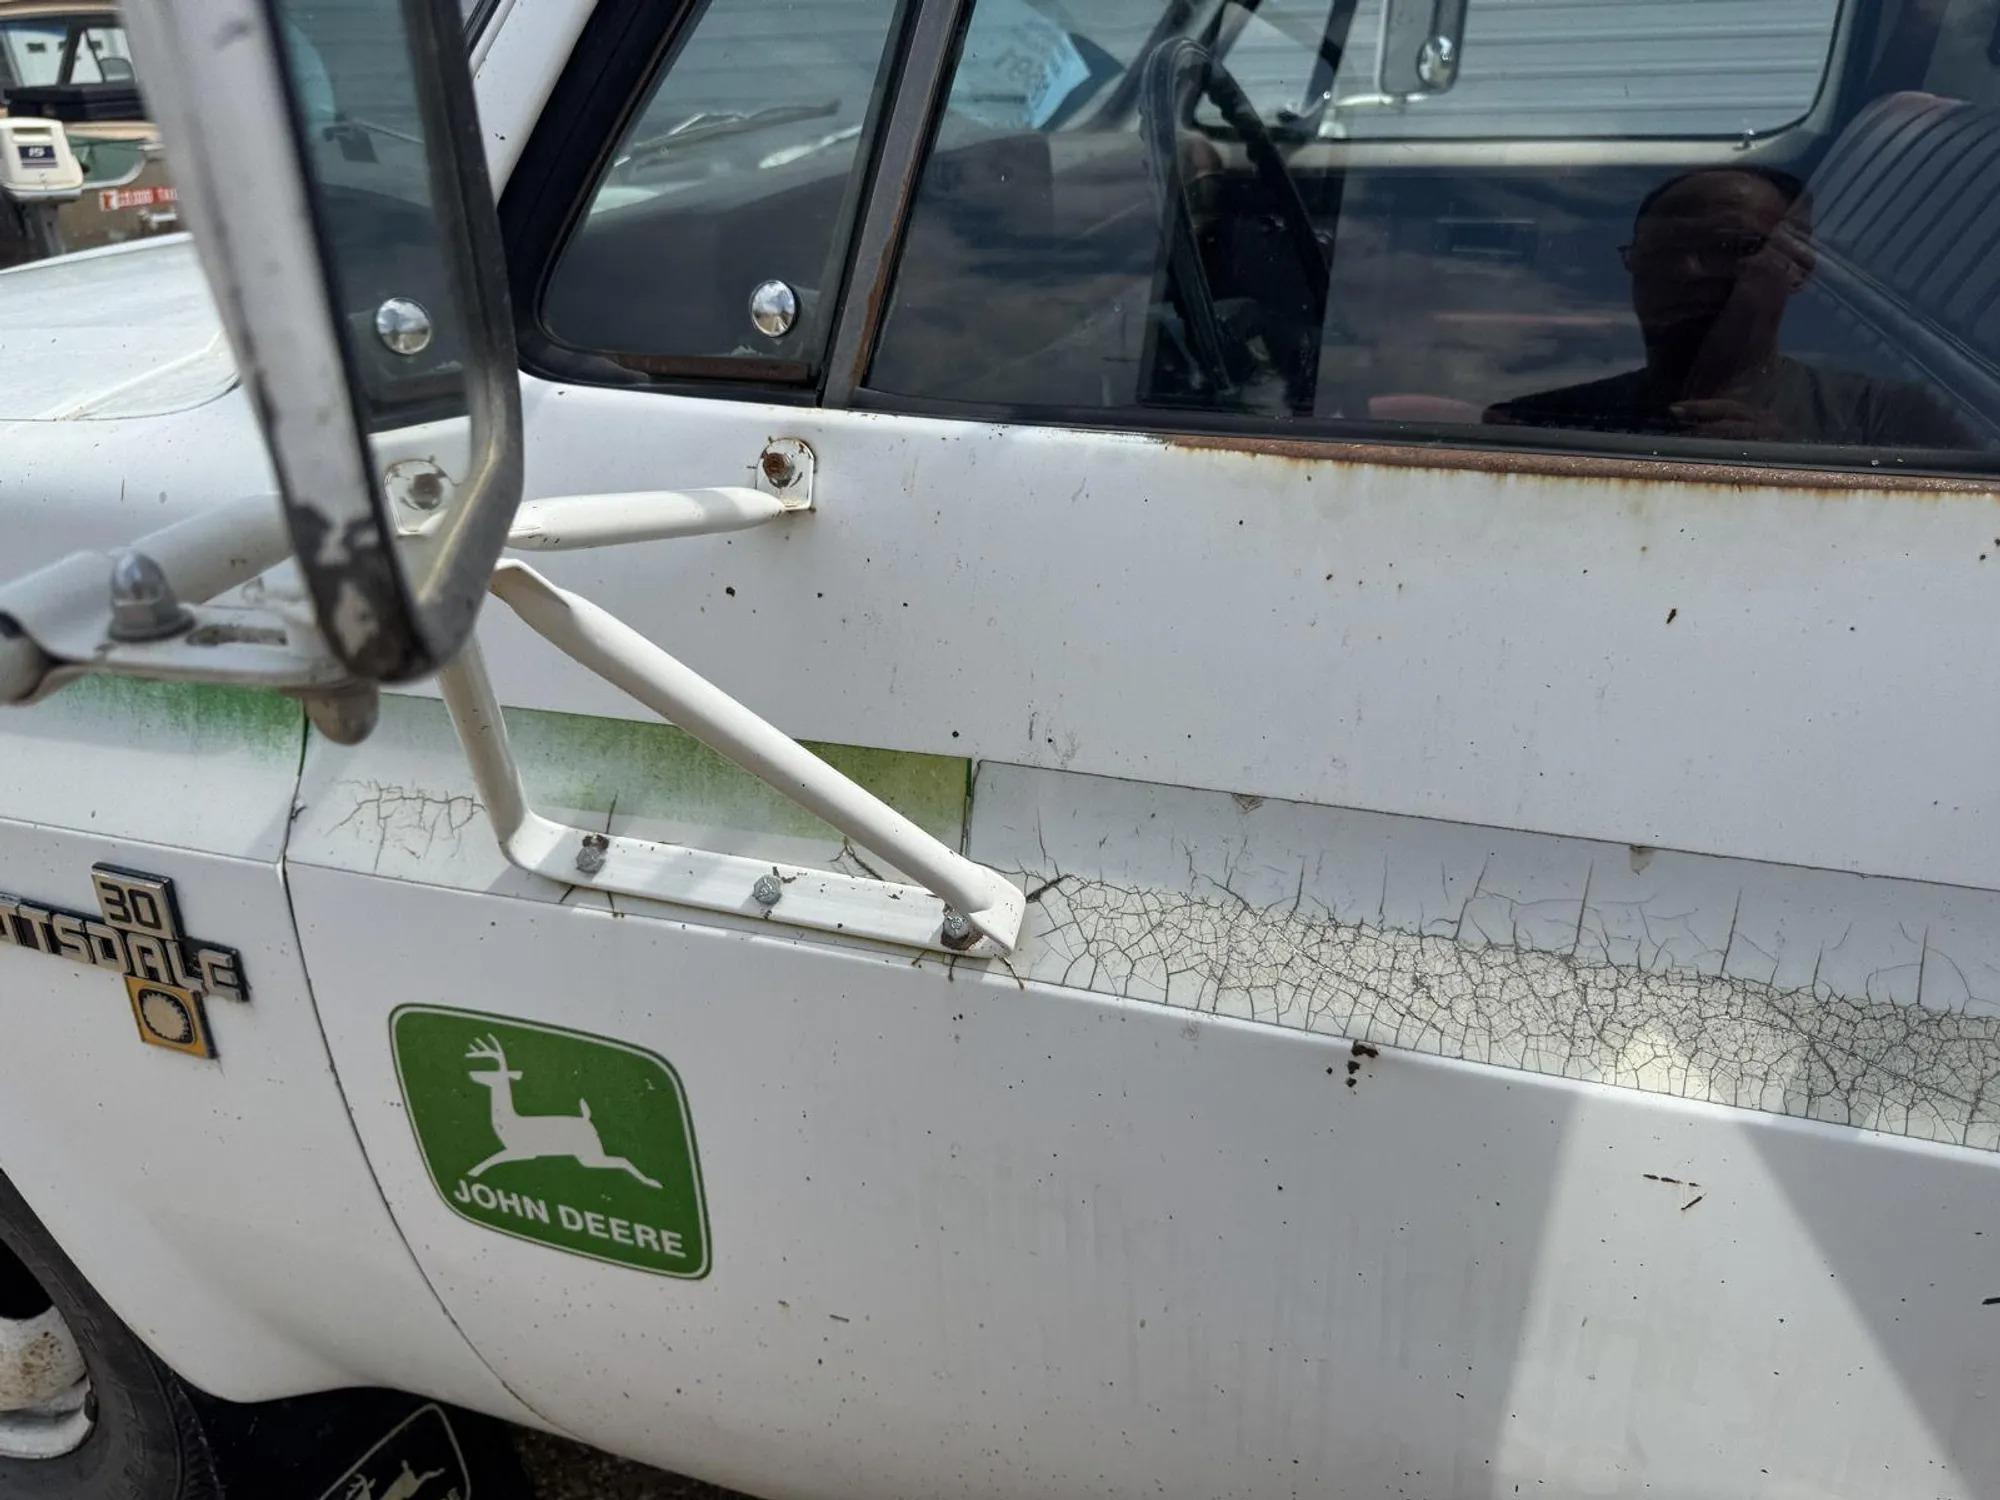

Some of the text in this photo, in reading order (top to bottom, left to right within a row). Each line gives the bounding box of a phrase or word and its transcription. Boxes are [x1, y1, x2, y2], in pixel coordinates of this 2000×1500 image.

[100, 882, 163, 930] 30
[454, 1179, 687, 1258] JOHN DEERE
